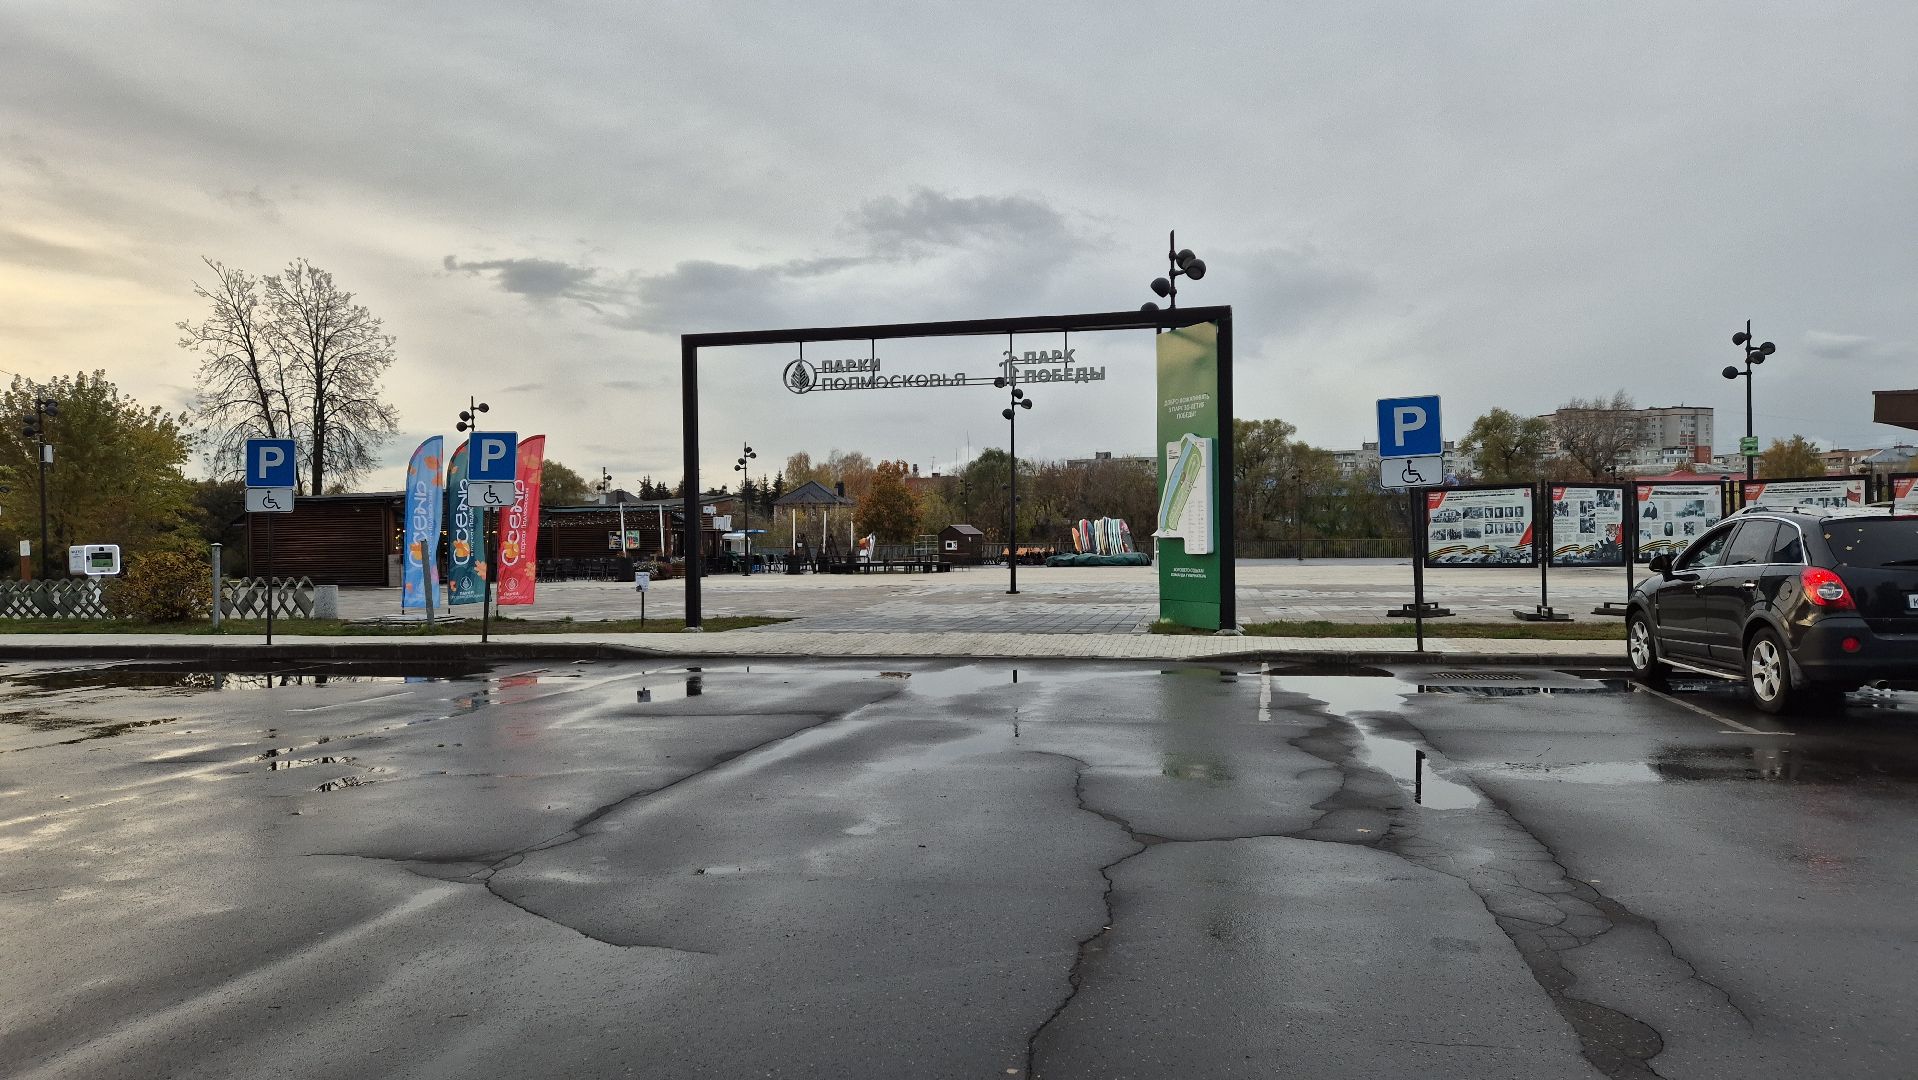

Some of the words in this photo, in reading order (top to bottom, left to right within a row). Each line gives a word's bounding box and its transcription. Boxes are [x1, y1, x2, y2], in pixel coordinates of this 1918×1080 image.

[822, 358, 880, 373] ПАРКИ
[1024, 349, 1075, 364] ПАРК
[822, 373, 966, 391] ПОДМОСКОВЬЯ
[1024, 366, 1105, 383] ПОБЕДЫ
[1393, 406, 1427, 447] P
[259, 447, 284, 478] P
[481, 439, 506, 471] P
